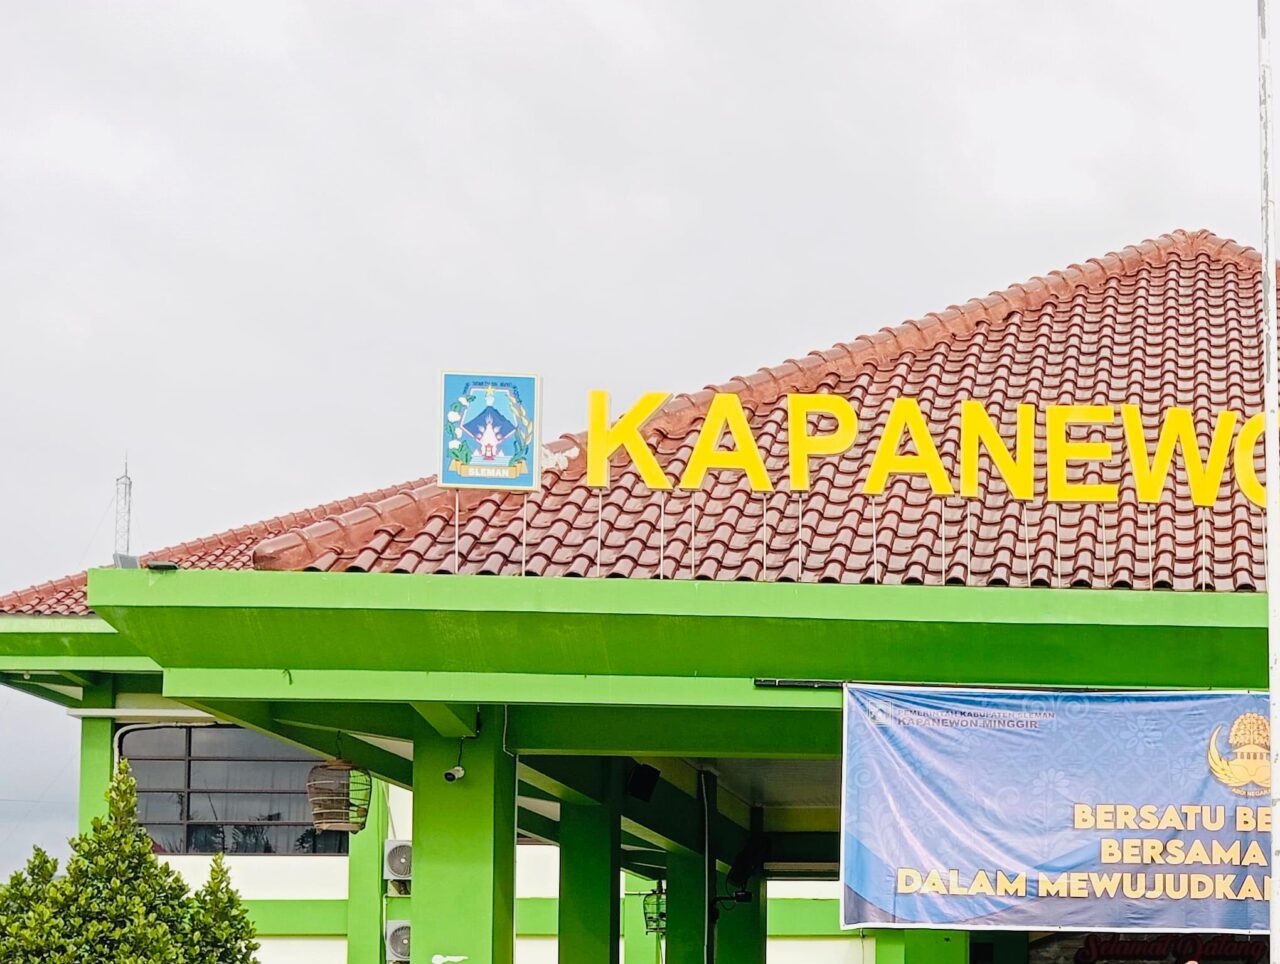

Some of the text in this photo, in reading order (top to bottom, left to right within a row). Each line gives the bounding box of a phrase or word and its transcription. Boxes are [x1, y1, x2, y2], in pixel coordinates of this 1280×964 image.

[897, 717, 1038, 729] KAPANEWON MINGGIR
[1073, 803, 1225, 831] BERSATU
[1100, 838, 1268, 868] BERSAMA
[897, 867, 1027, 897] DALAM
